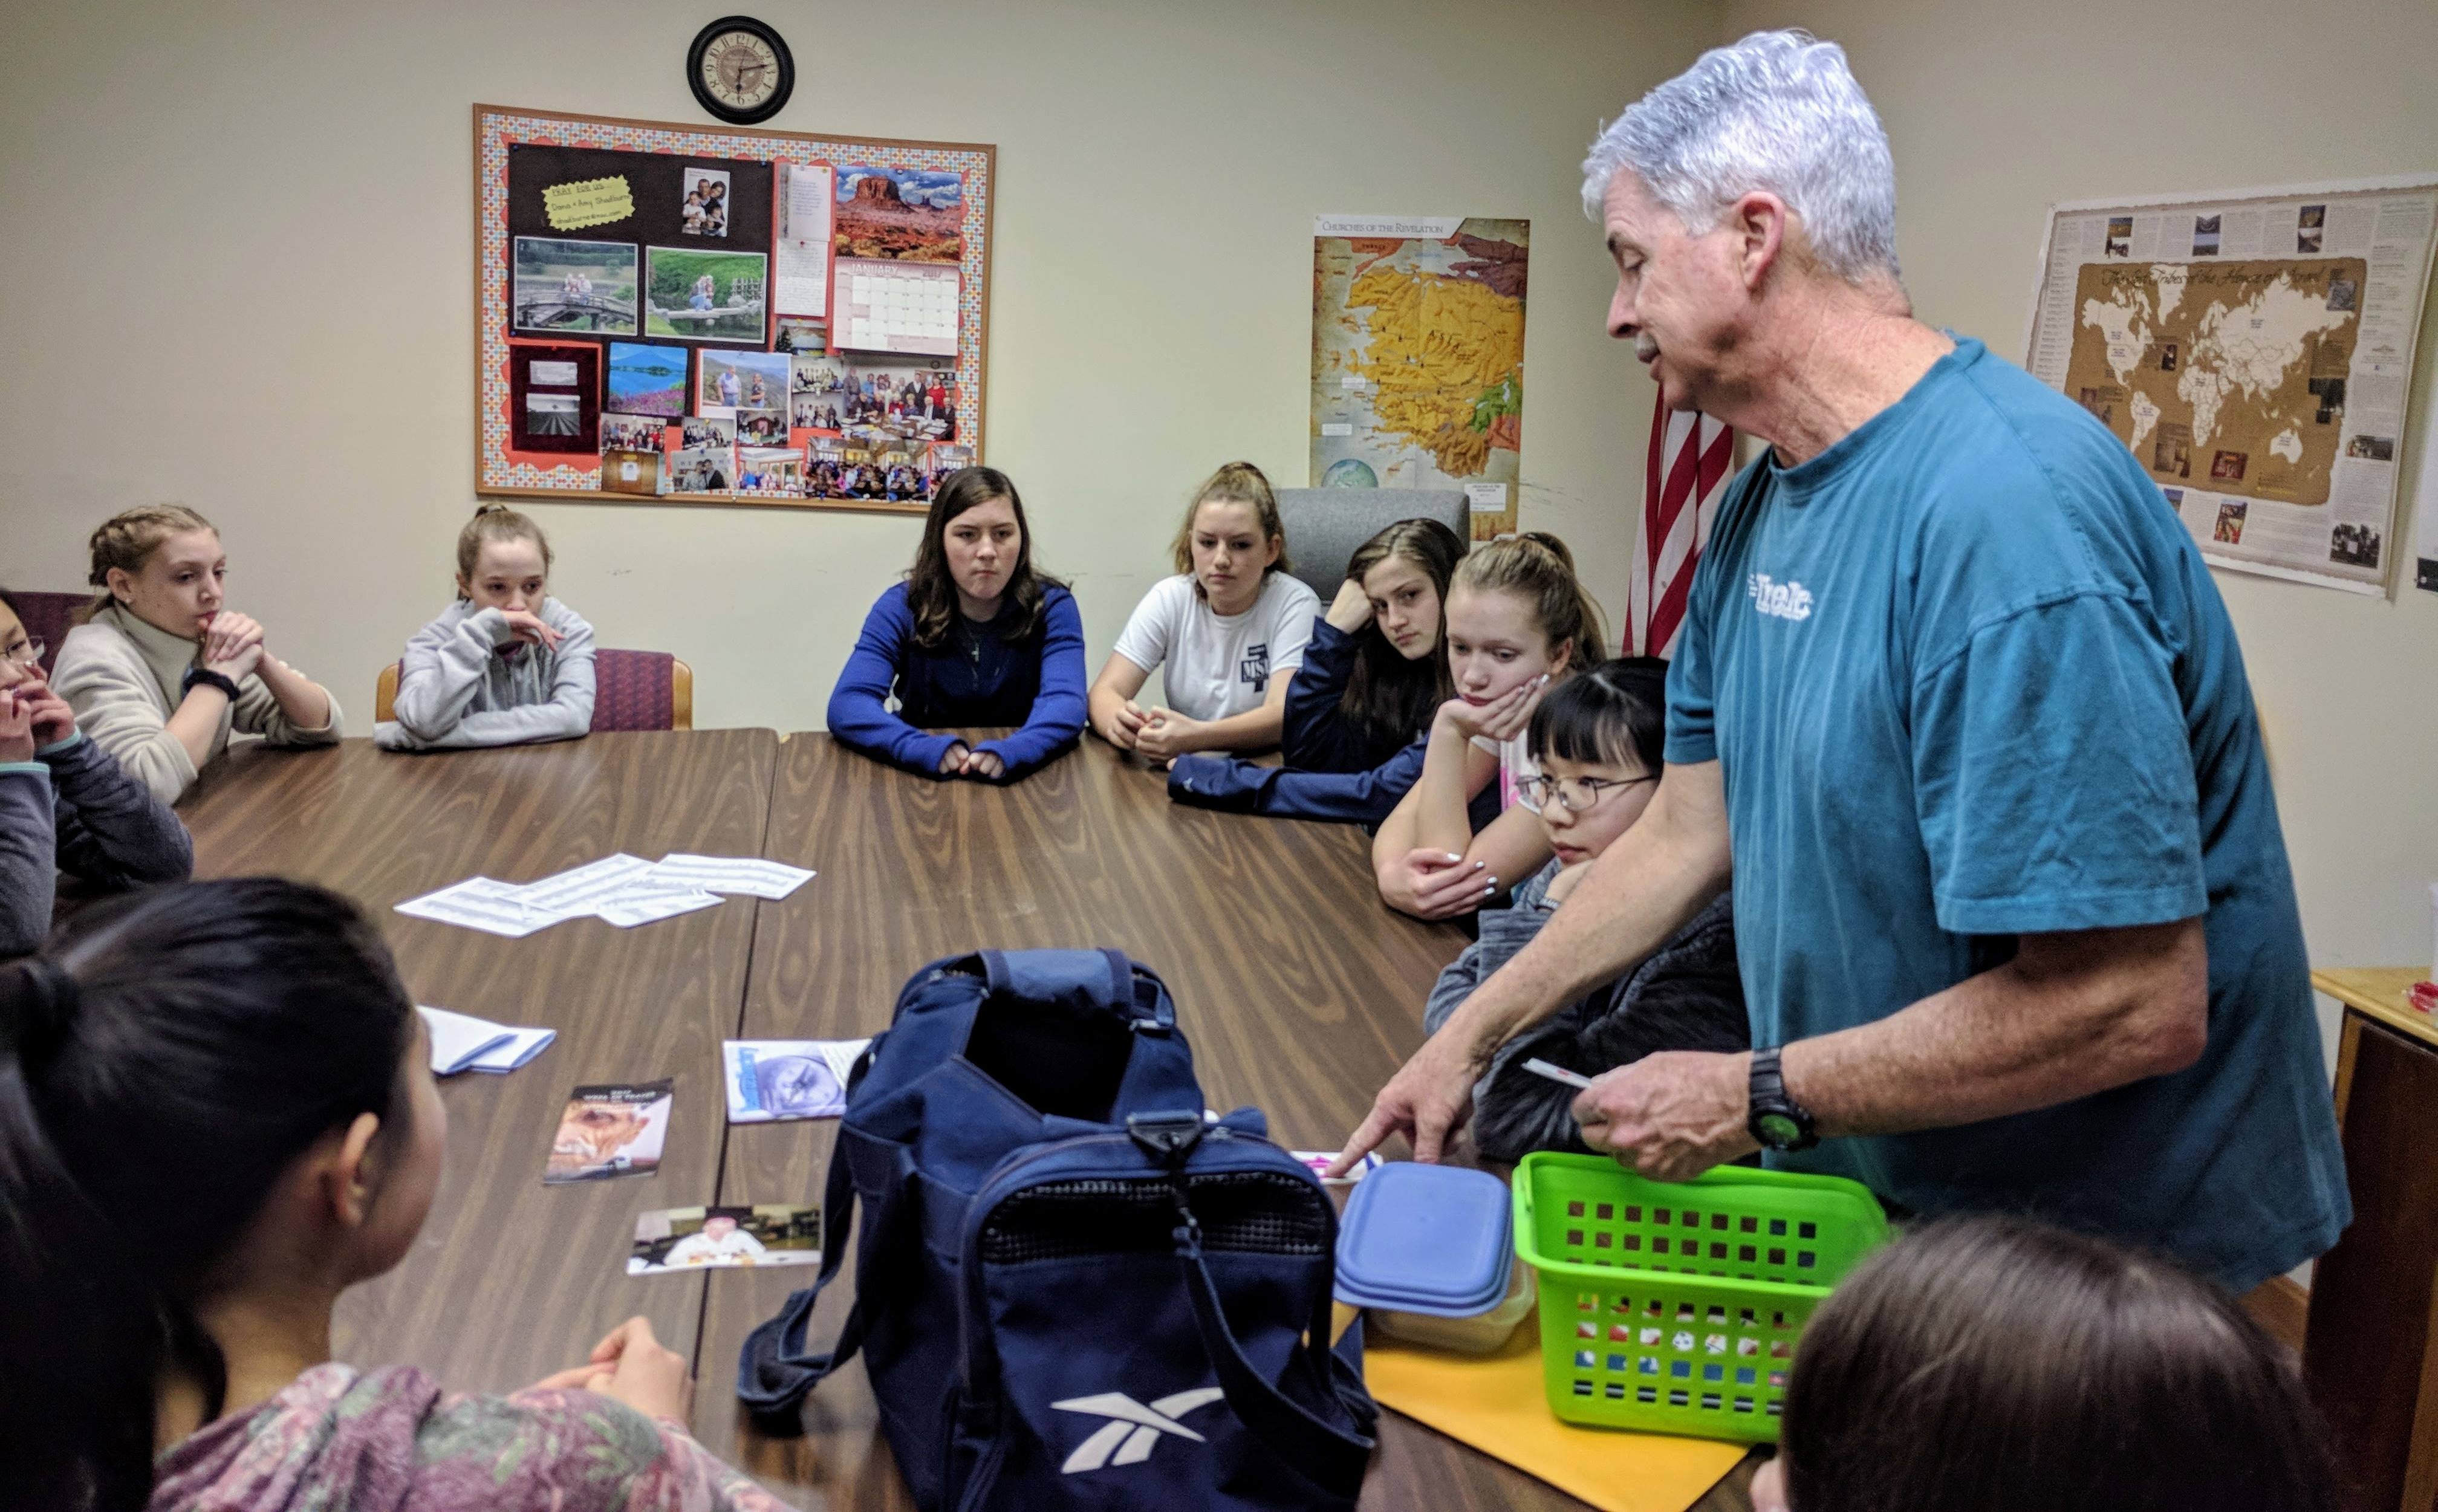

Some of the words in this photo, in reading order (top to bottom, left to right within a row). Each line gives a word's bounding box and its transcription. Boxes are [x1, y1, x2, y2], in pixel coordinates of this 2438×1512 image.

[736, 33, 746, 45] 12
[1322, 221, 1364, 232] CHURCHES
[1366, 223, 1376, 232] OF
[1378, 224, 1393, 233] THE
[1395, 222, 1443, 233] REVELATION
[851, 264, 898, 274] JANUARY
